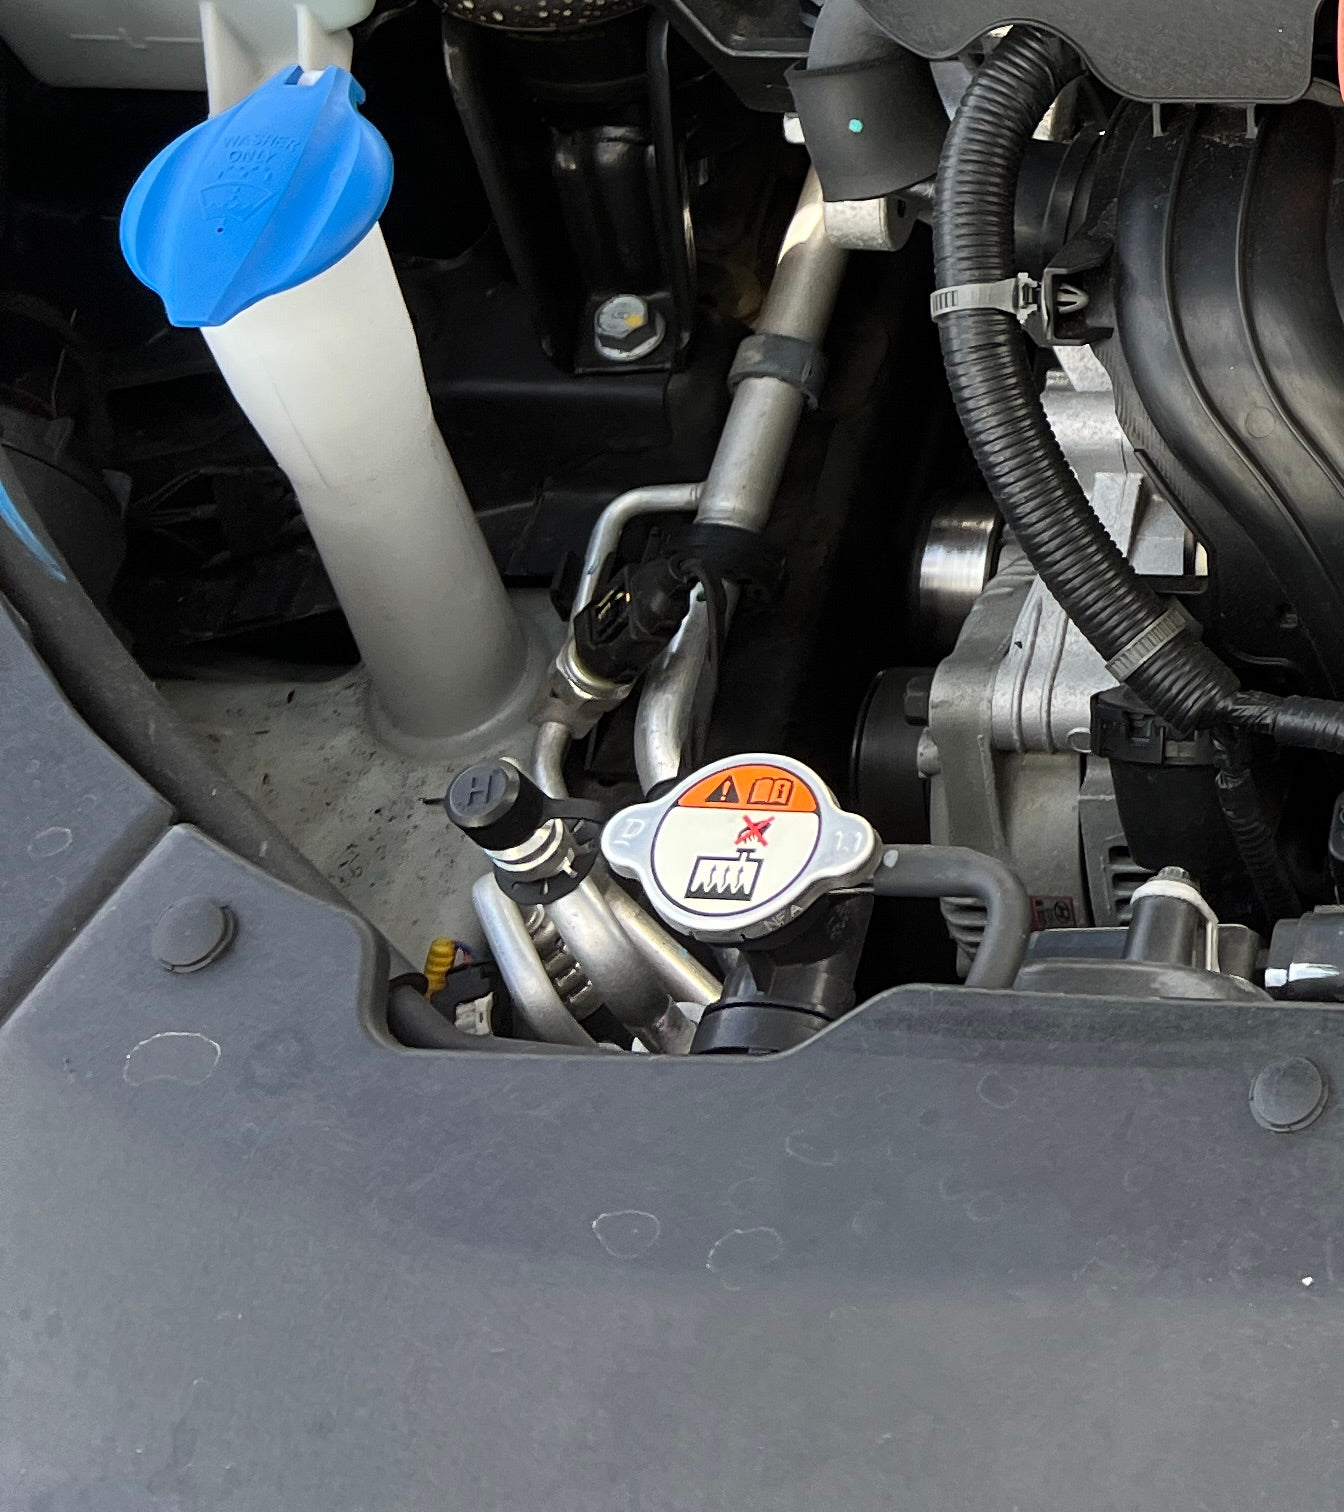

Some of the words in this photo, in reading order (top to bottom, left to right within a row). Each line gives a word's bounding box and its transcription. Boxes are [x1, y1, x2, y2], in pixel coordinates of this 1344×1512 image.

[223, 133, 301, 152] WASHER
[228, 149, 278, 163] ONLY
[467, 774, 493, 807] H
